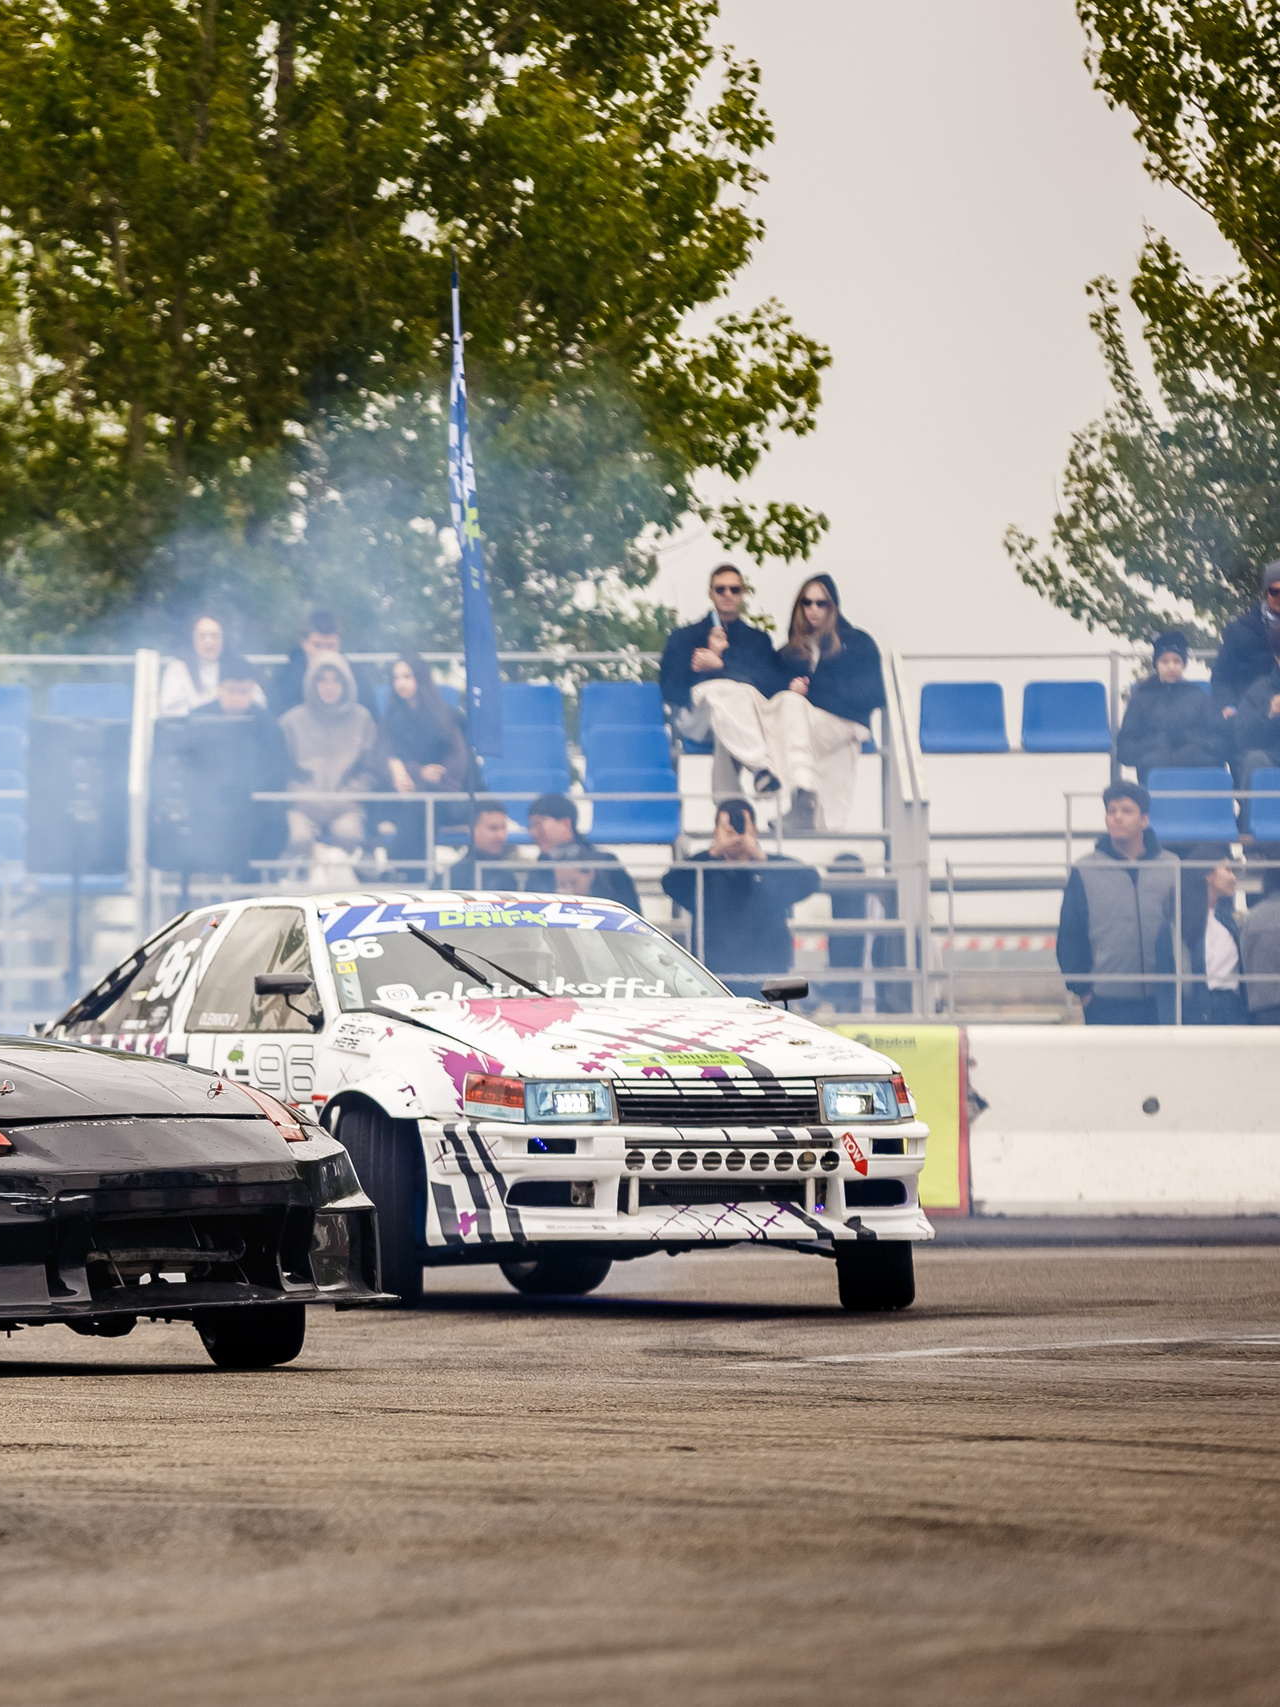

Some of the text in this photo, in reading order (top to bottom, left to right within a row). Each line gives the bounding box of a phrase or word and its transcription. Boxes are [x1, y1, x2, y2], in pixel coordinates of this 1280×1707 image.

[439, 909, 548, 928] DRIFT
[329, 936, 384, 962] 96
[146, 938, 202, 1002] 96
[254, 1043, 316, 1104] 96
[842, 1135, 864, 1164] TOW
